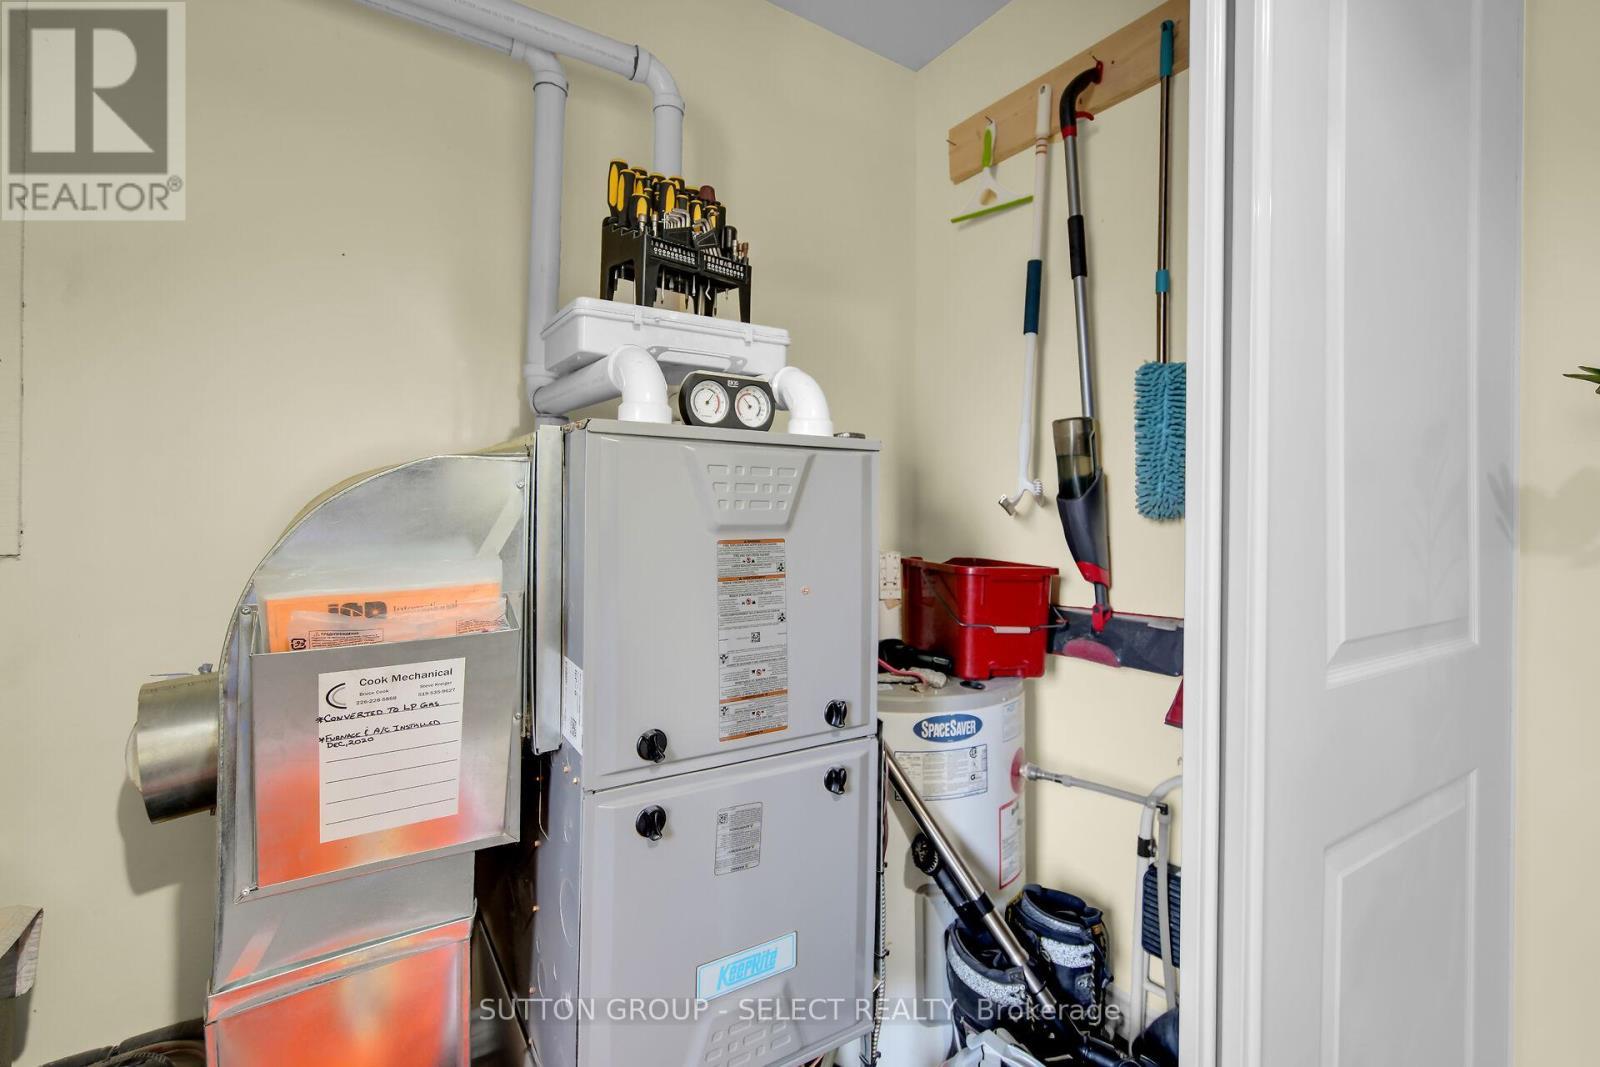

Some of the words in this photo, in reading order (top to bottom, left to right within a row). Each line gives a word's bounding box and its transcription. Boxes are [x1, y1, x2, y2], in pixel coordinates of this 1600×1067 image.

[359, 677, 388, 687] Cook
[391, 667, 453, 682] Mechanical
[387, 706, 399, 714] TO
[403, 703, 417, 711] LP
[420, 701, 440, 709] GAS
[373, 726, 390, 735] A/C
[392, 719, 441, 732] INSTALLED
